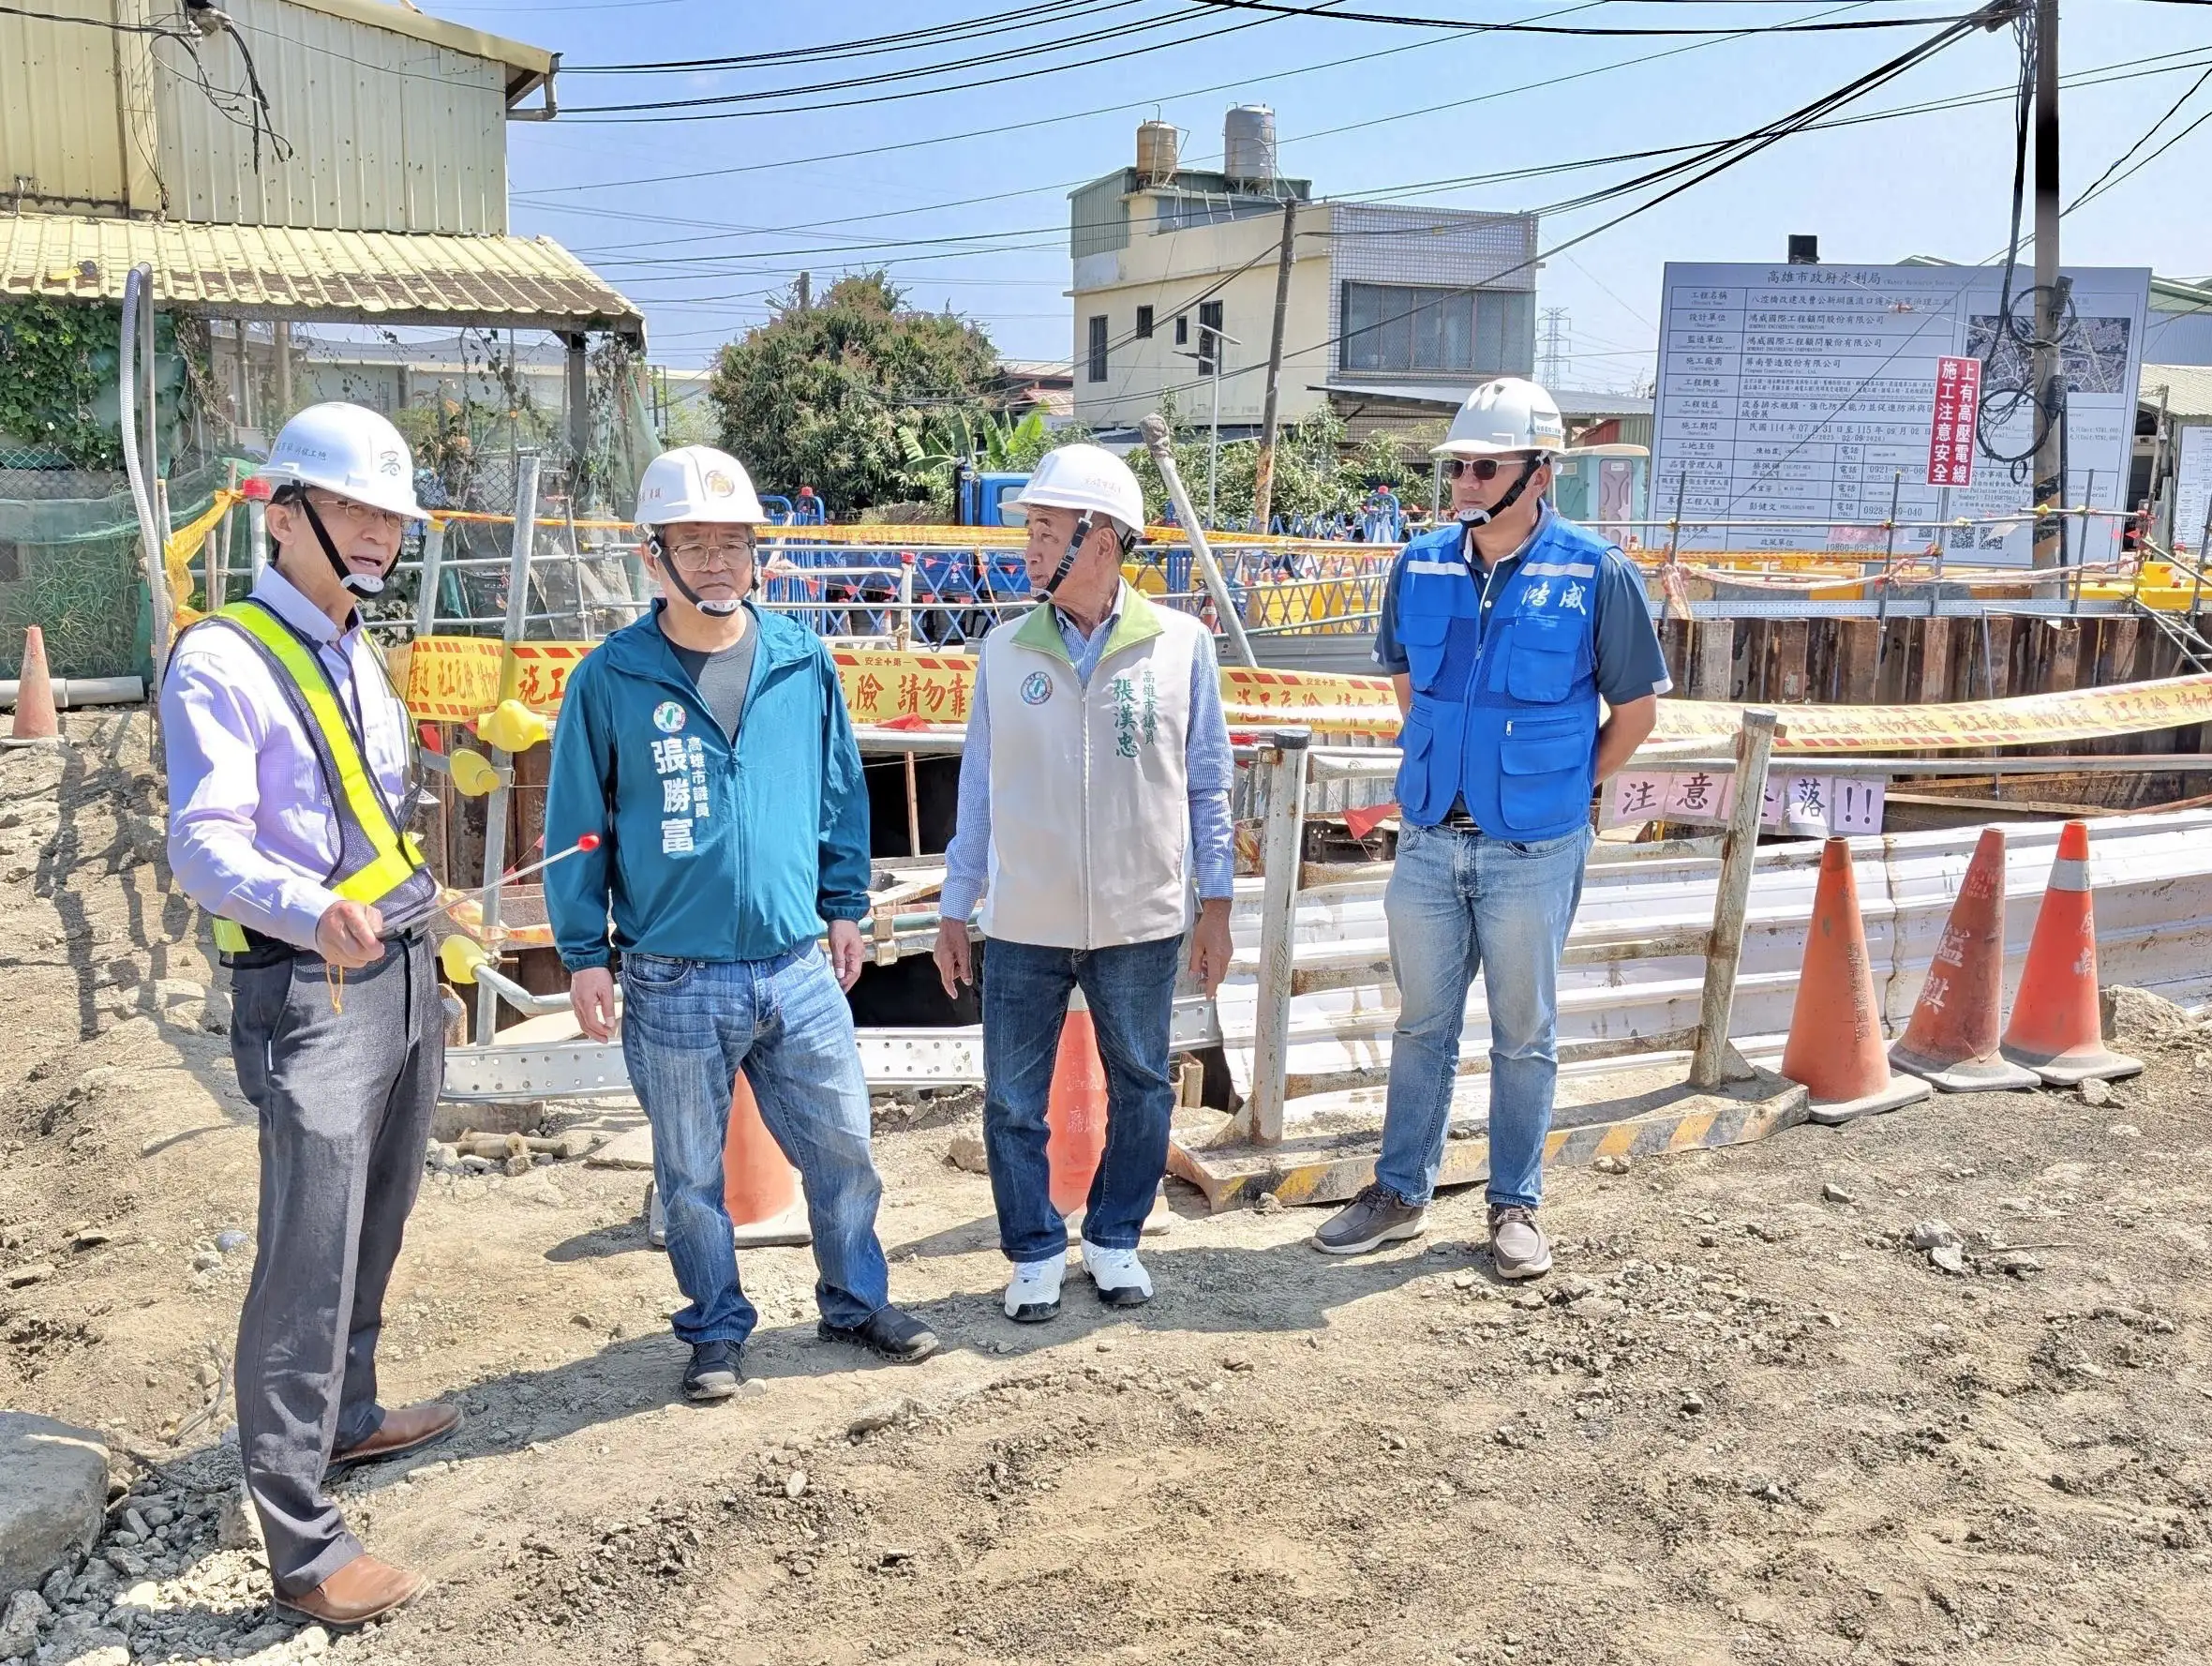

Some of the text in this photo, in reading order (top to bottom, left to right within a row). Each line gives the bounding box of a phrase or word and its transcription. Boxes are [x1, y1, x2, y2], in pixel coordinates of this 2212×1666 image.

[1768, 270, 1881, 285] 高雄市政府水利局
[1691, 291, 1727, 300] 工程名稱
[1689, 313, 1726, 322] 設計單位
[1687, 335, 1724, 344] 監造單位
[1686, 357, 1723, 367] 施工廠商
[1682, 400, 1719, 409] 工程效益
[1681, 422, 1717, 430] 施工期間
[1933, 360, 1958, 482] 施工注意安全
[1951, 362, 1976, 484] 上有高壓電線
[1680, 442, 1715, 450] 工地主任
[1841, 445, 1859, 455] 電話
[1669, 460, 1723, 470] 品質管理人員
[1839, 465, 1857, 474] 電話
[1837, 483, 1855, 492] 電話
[1667, 497, 1721, 506] 專工程人員
[1836, 502, 1854, 511] 電話
[897, 672, 975, 718] 請勿靠
[1142, 670, 1158, 746] 高雄市議員
[1113, 678, 1139, 758] 張漢忠
[686, 736, 710, 818] 高雄市議員
[650, 736, 695, 854] 張勝富
